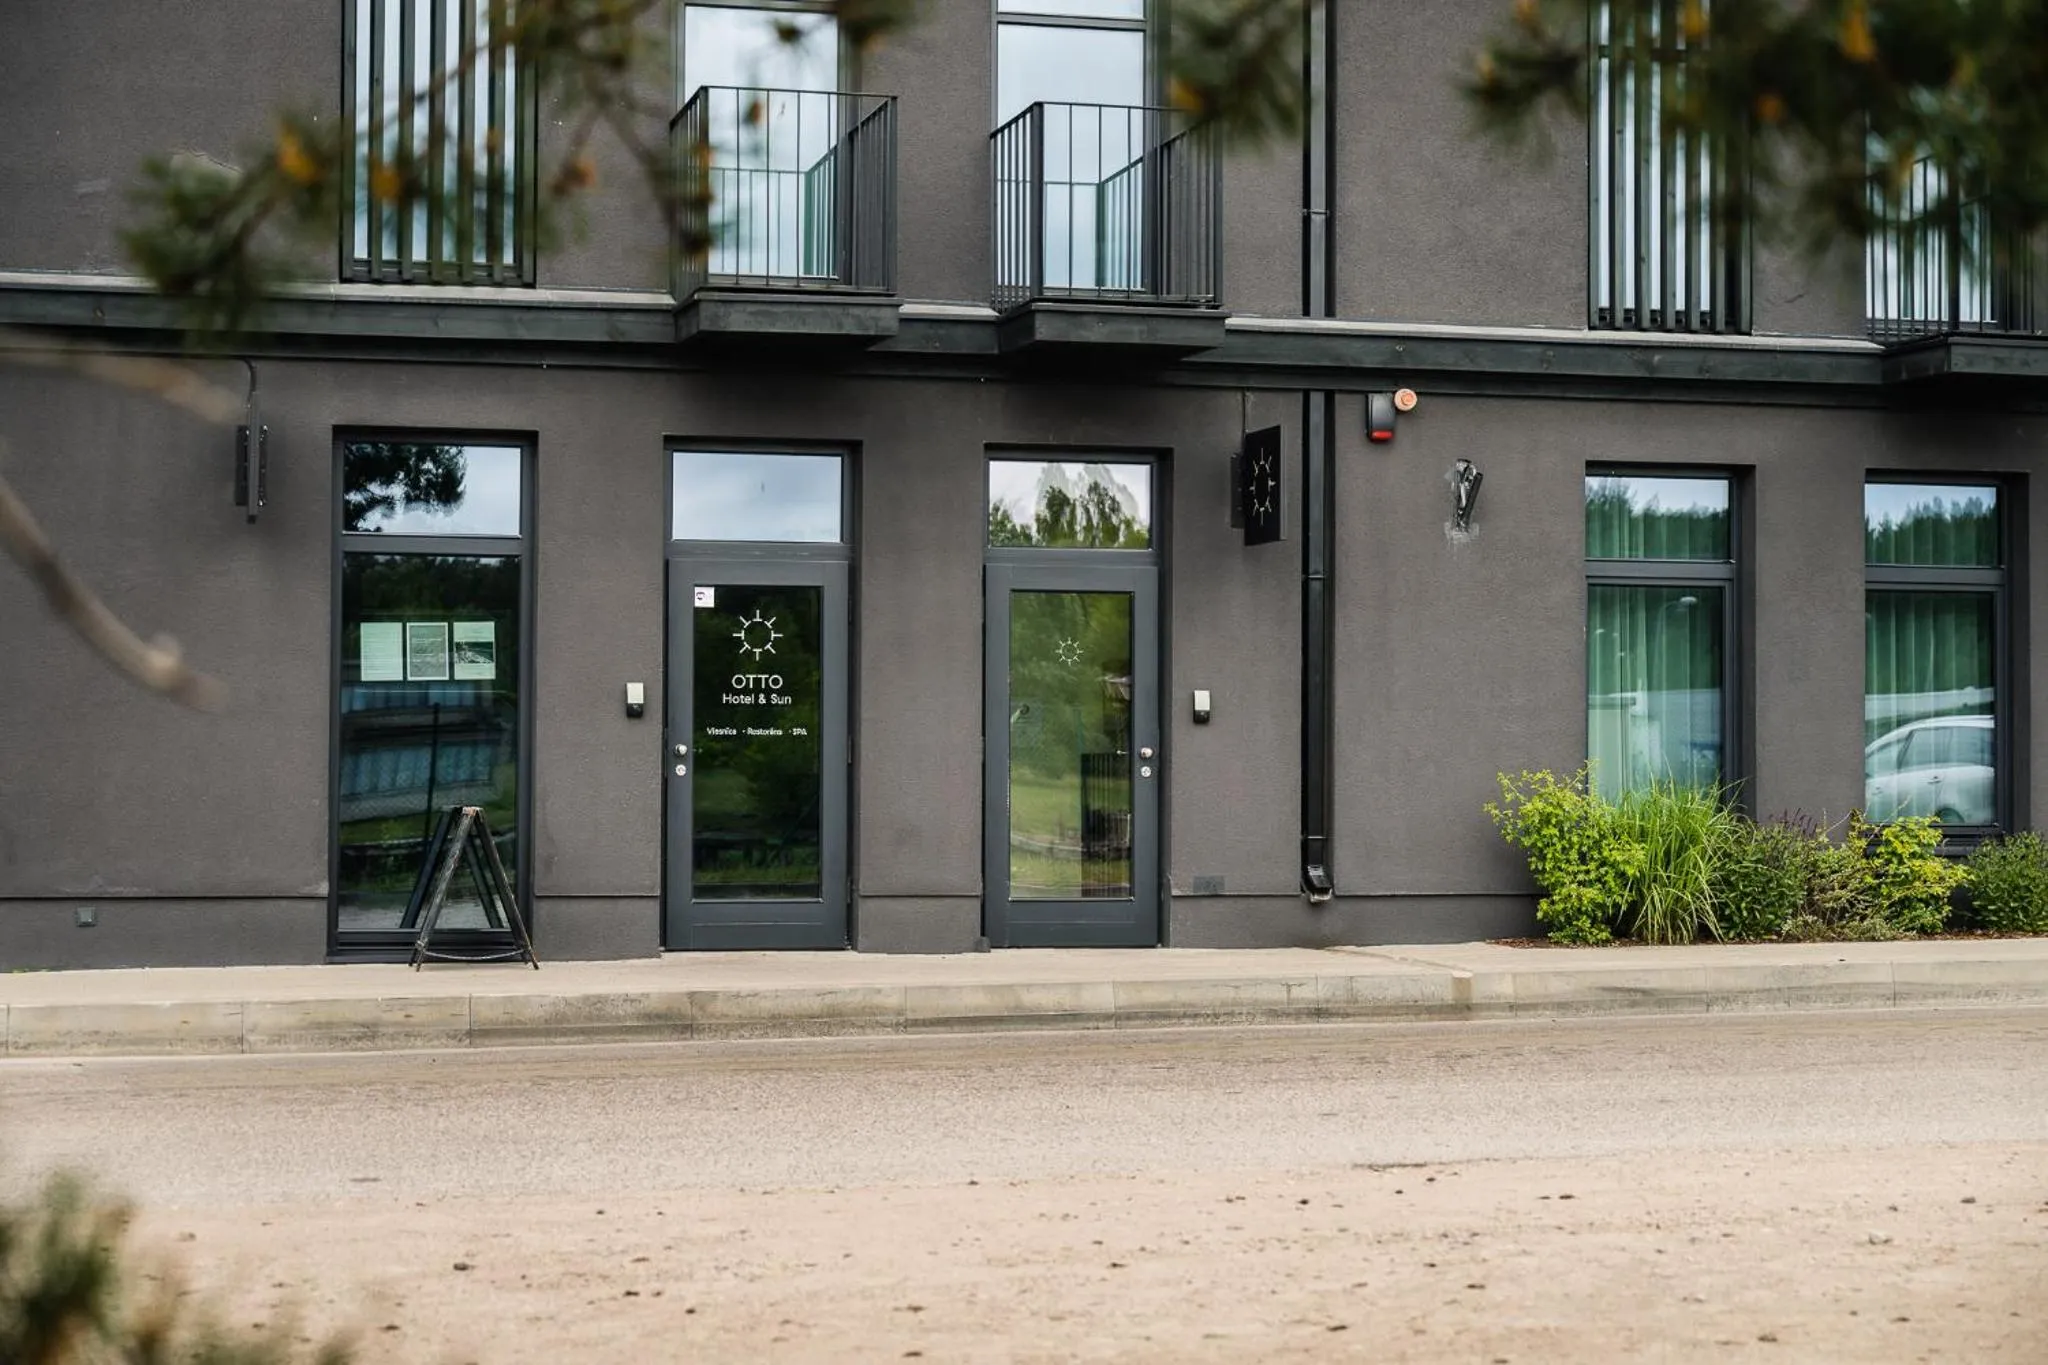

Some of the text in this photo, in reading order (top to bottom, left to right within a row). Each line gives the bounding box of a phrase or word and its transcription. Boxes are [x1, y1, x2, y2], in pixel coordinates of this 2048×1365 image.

[731, 674, 783, 689] OTTO
[722, 693, 792, 705] Hotel & Sun
[792, 727, 808, 736] SPA
